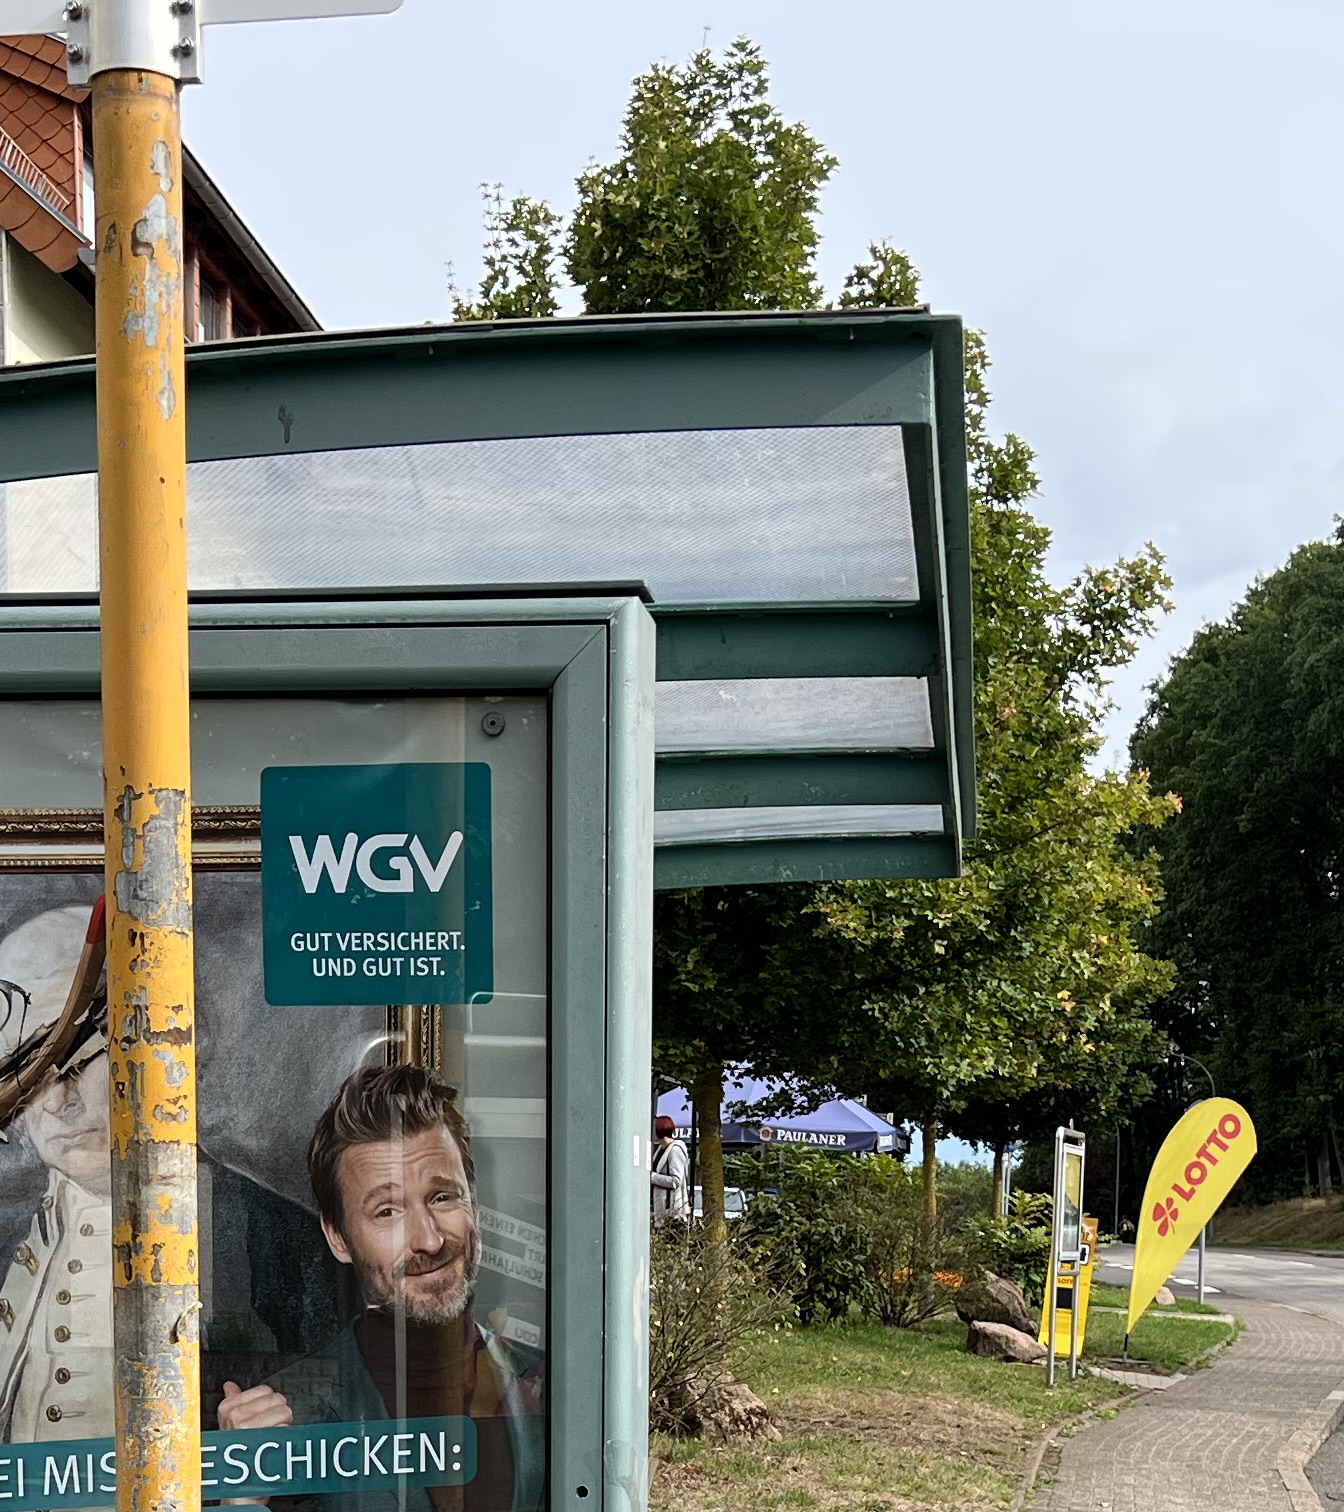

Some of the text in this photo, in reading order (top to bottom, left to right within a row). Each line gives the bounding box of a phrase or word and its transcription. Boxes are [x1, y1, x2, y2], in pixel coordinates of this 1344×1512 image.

[288, 830, 464, 894] WGV
[290, 931, 466, 952] GUT VERSICHERT.
[312, 956, 446, 977] UND GUT IST.
[776, 1128, 847, 1147] PAULANER
[1171, 1113, 1242, 1202] LOTTO
[43, 1431, 462, 1496] MISESCHICKEN:
